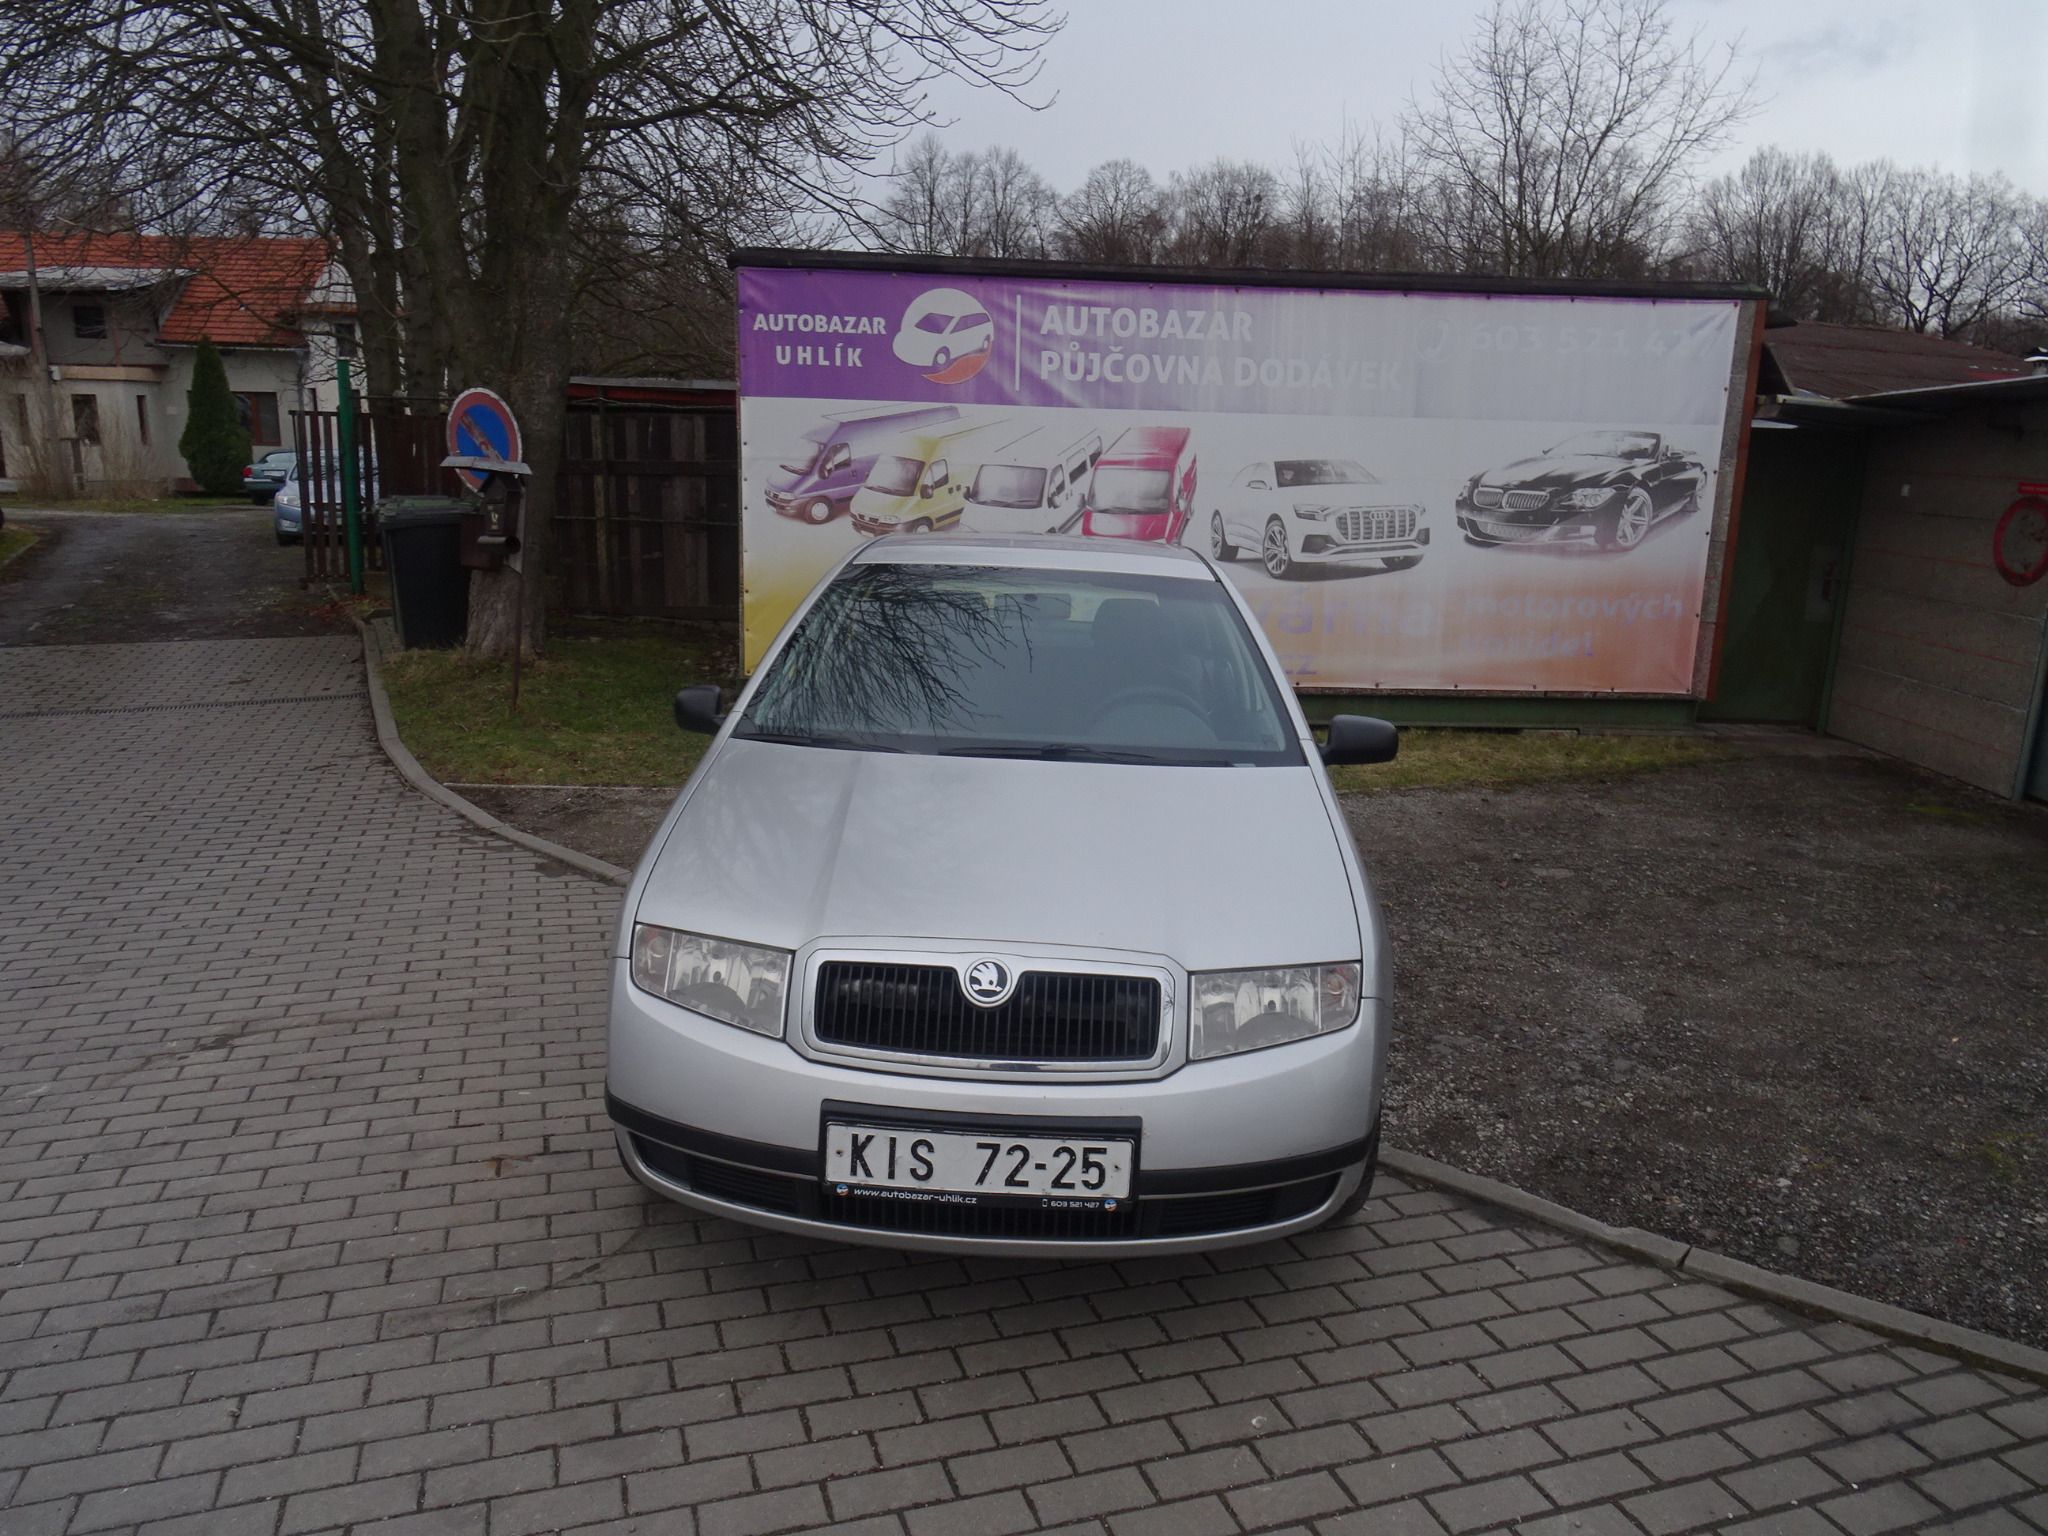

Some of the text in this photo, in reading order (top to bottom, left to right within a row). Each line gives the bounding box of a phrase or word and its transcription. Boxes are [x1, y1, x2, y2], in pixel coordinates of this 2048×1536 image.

[753, 313, 887, 335] AUTOBAZAR
[1040, 305, 1252, 341] AUTOBAZAR
[775, 343, 863, 367] UHLÍK
[1040, 341, 1402, 391] PŮJČOVNA DODÁVEK
[850, 1133, 1108, 1190] KIS 72-25
[854, 1188, 977, 1204] www.autobazar-uhlik.cz
[1050, 1200, 1067, 1208] 603
